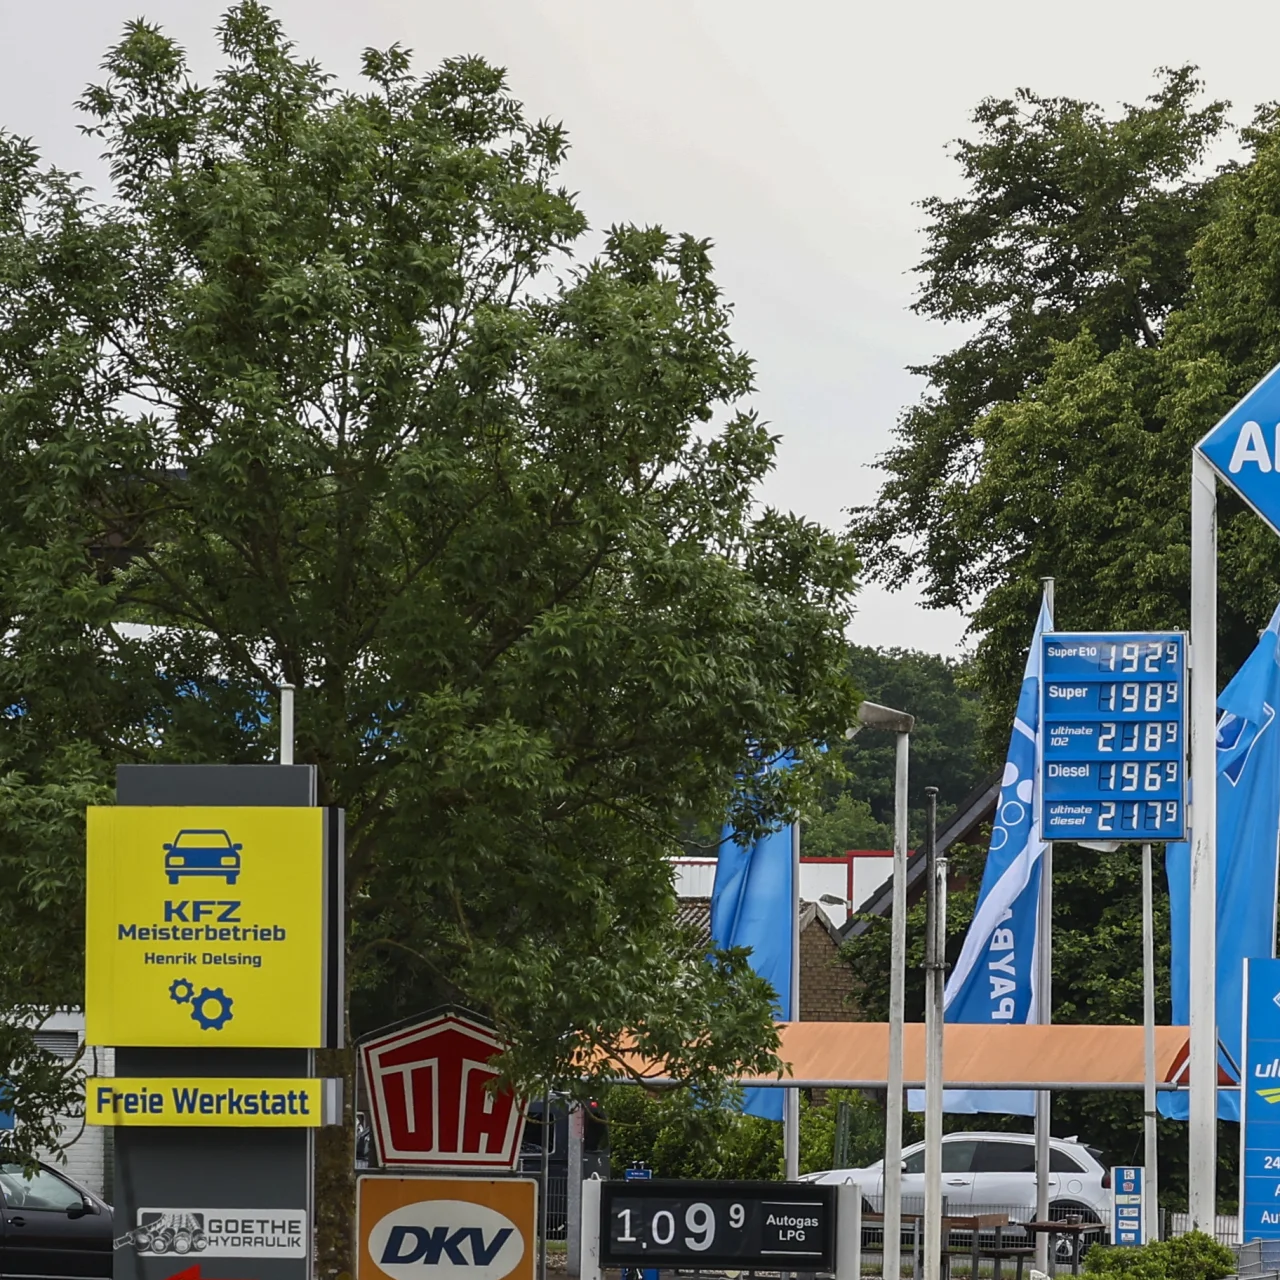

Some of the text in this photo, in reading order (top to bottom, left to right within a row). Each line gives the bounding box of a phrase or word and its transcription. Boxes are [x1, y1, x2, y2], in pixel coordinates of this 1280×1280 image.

[1047, 647, 1077, 659] Super
[1079, 647, 1097, 657] E10
[1049, 686, 1088, 701] Super
[1050, 726, 1093, 736] ultimate
[1050, 737, 1069, 746] 102
[1048, 764, 1090, 777] Diesel
[1050, 805, 1093, 815] ultimate
[1050, 816, 1086, 826] diesel
[163, 900, 242, 923] KFZ
[118, 924, 287, 942] Meisterbetrieb
[144, 952, 262, 968] Henrik Delsing
[378, 1028, 516, 1155] UTA
[97, 1087, 310, 1115] Freie Werkstatt
[208, 1219, 302, 1235] GOETHE
[766, 1214, 819, 1229] Autogas
[207, 1236, 302, 1248] HYDRAULIK
[778, 1229, 806, 1242] LPG
[380, 1225, 515, 1267] DKV
